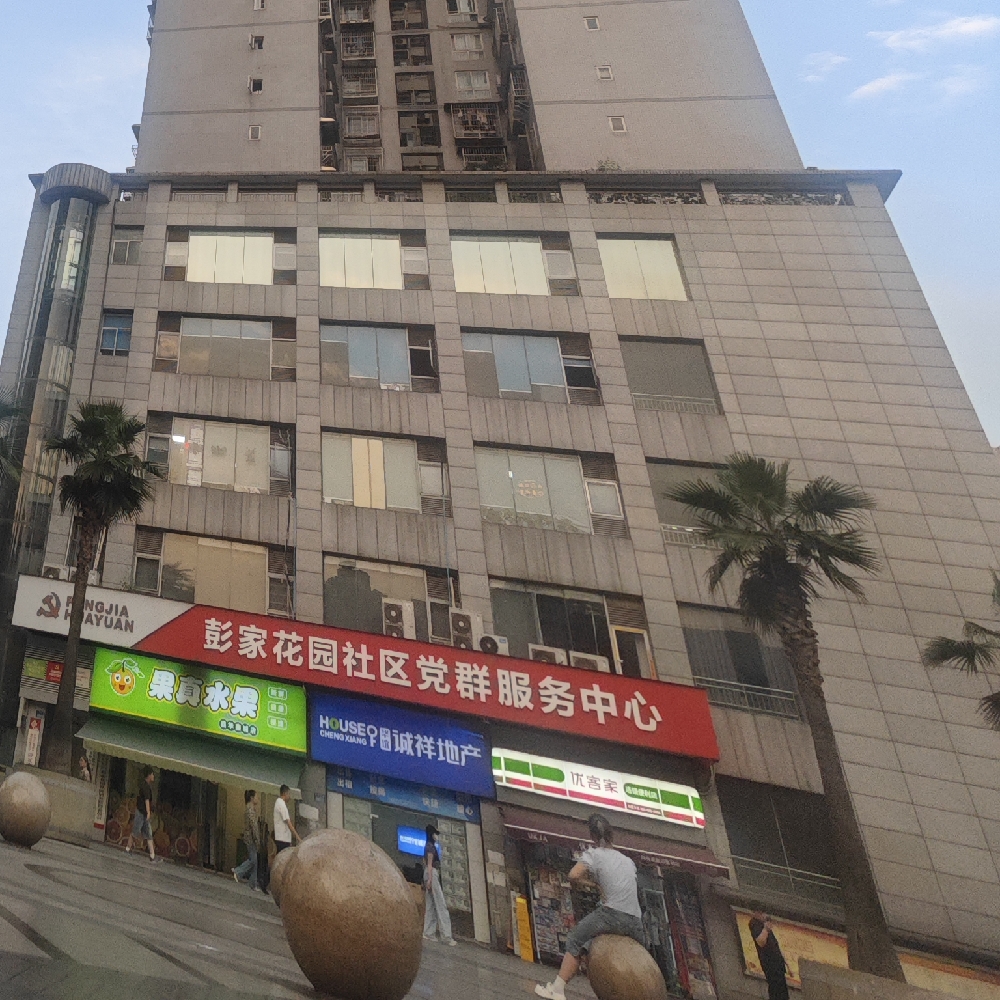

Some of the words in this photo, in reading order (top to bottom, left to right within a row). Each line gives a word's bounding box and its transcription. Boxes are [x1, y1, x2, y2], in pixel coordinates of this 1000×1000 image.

[65, 596, 129, 618] PNGJIA
[64, 608, 134, 633] HAYUAN
[203, 617, 663, 732] 彭家花园社区党群服务中心
[148, 668, 260, 719] 果真水果
[319, 714, 367, 737] HOUSE
[319, 729, 344, 742] CHENG
[344, 735, 367, 746] XIANG
[392, 729, 482, 767] 诚祥地产
[570, 771, 618, 794] 优客家
